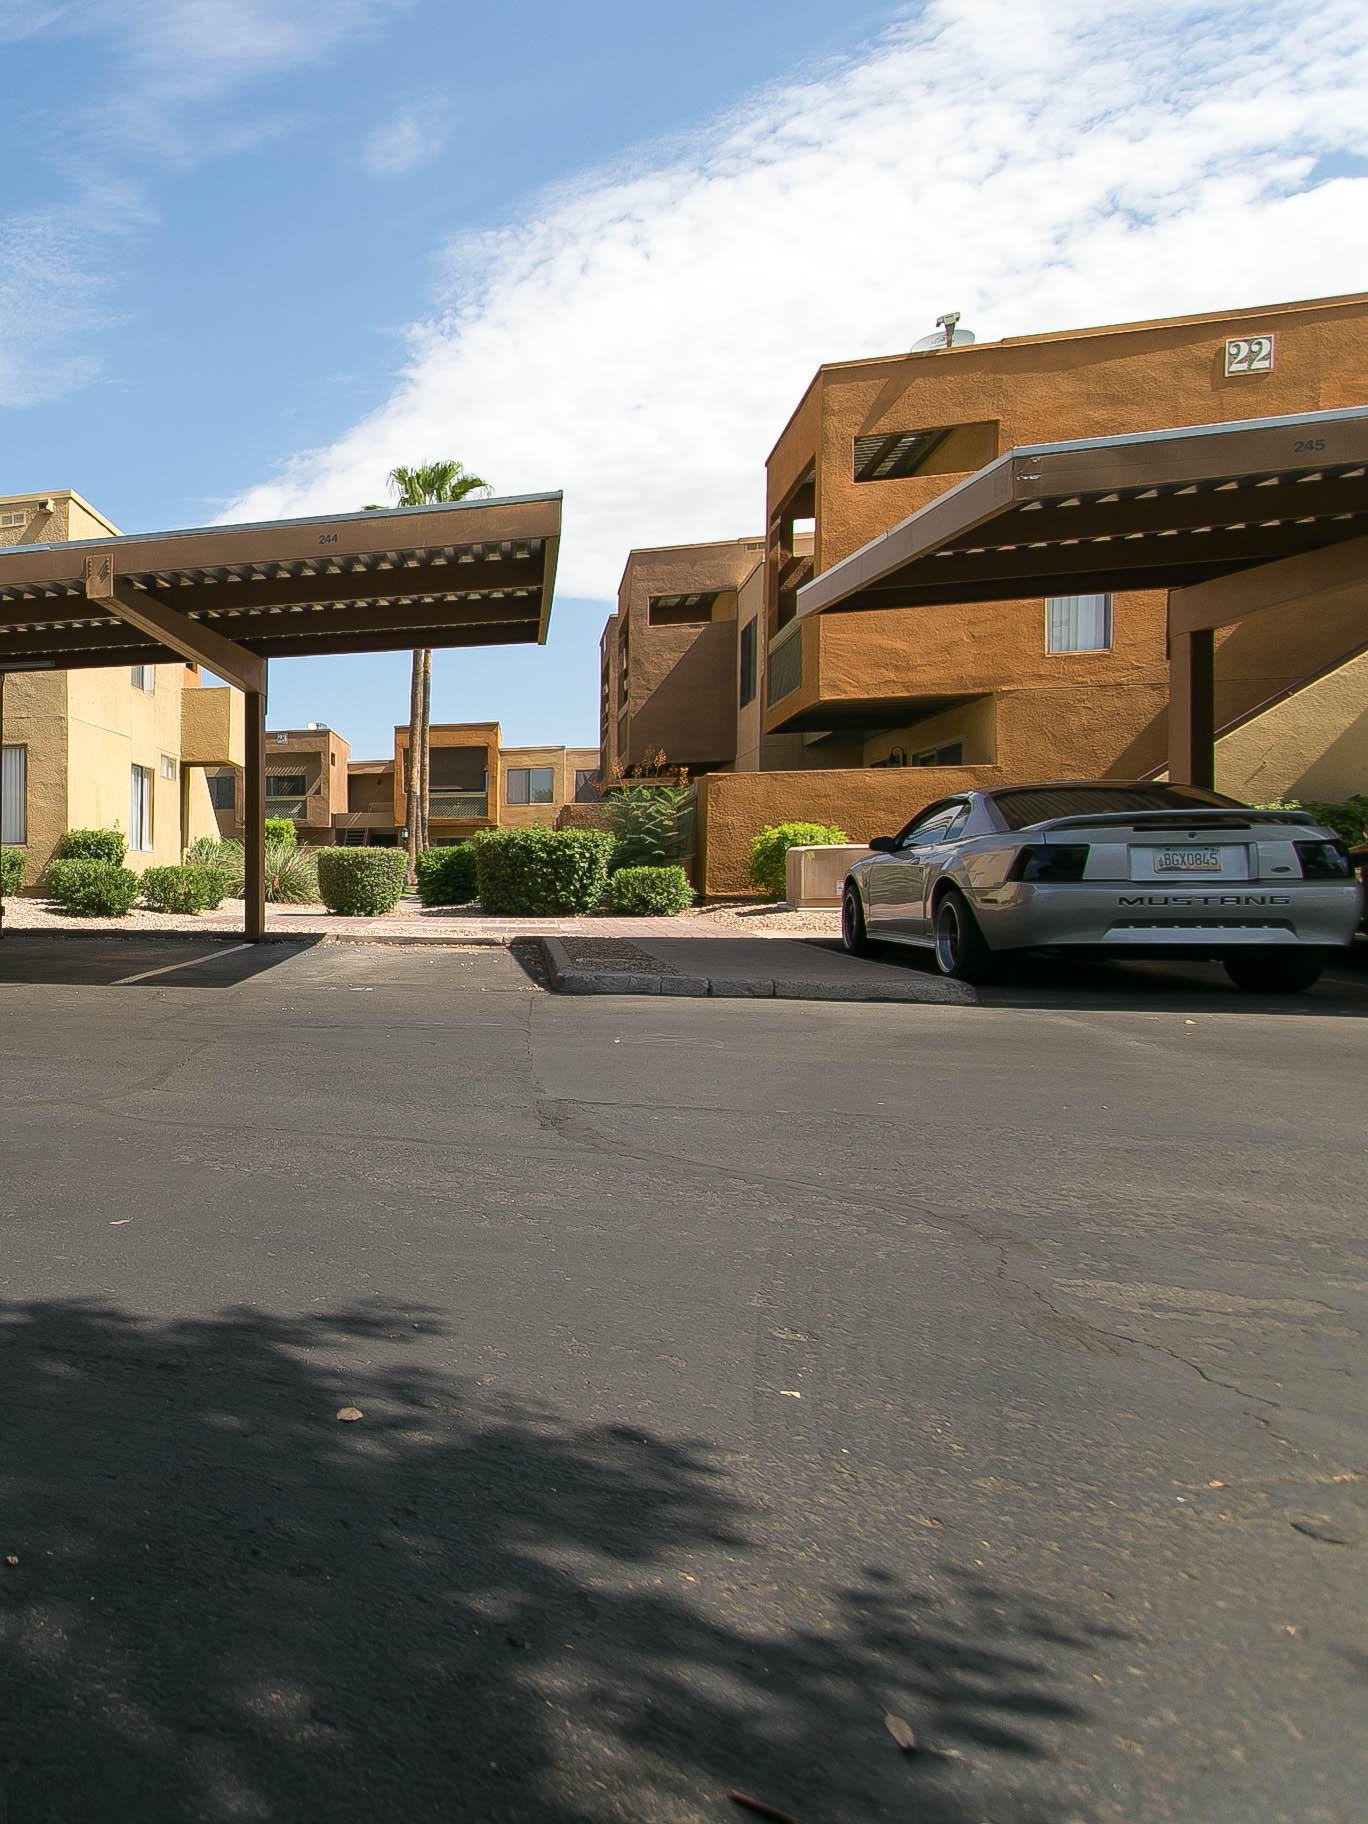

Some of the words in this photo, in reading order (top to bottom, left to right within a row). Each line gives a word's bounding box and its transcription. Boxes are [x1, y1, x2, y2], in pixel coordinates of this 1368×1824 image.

[1229, 338, 1271, 371] 22
[1293, 440, 1326, 452] 245
[318, 534, 338, 544] 244
[1117, 895, 1290, 907] MUSTANG
